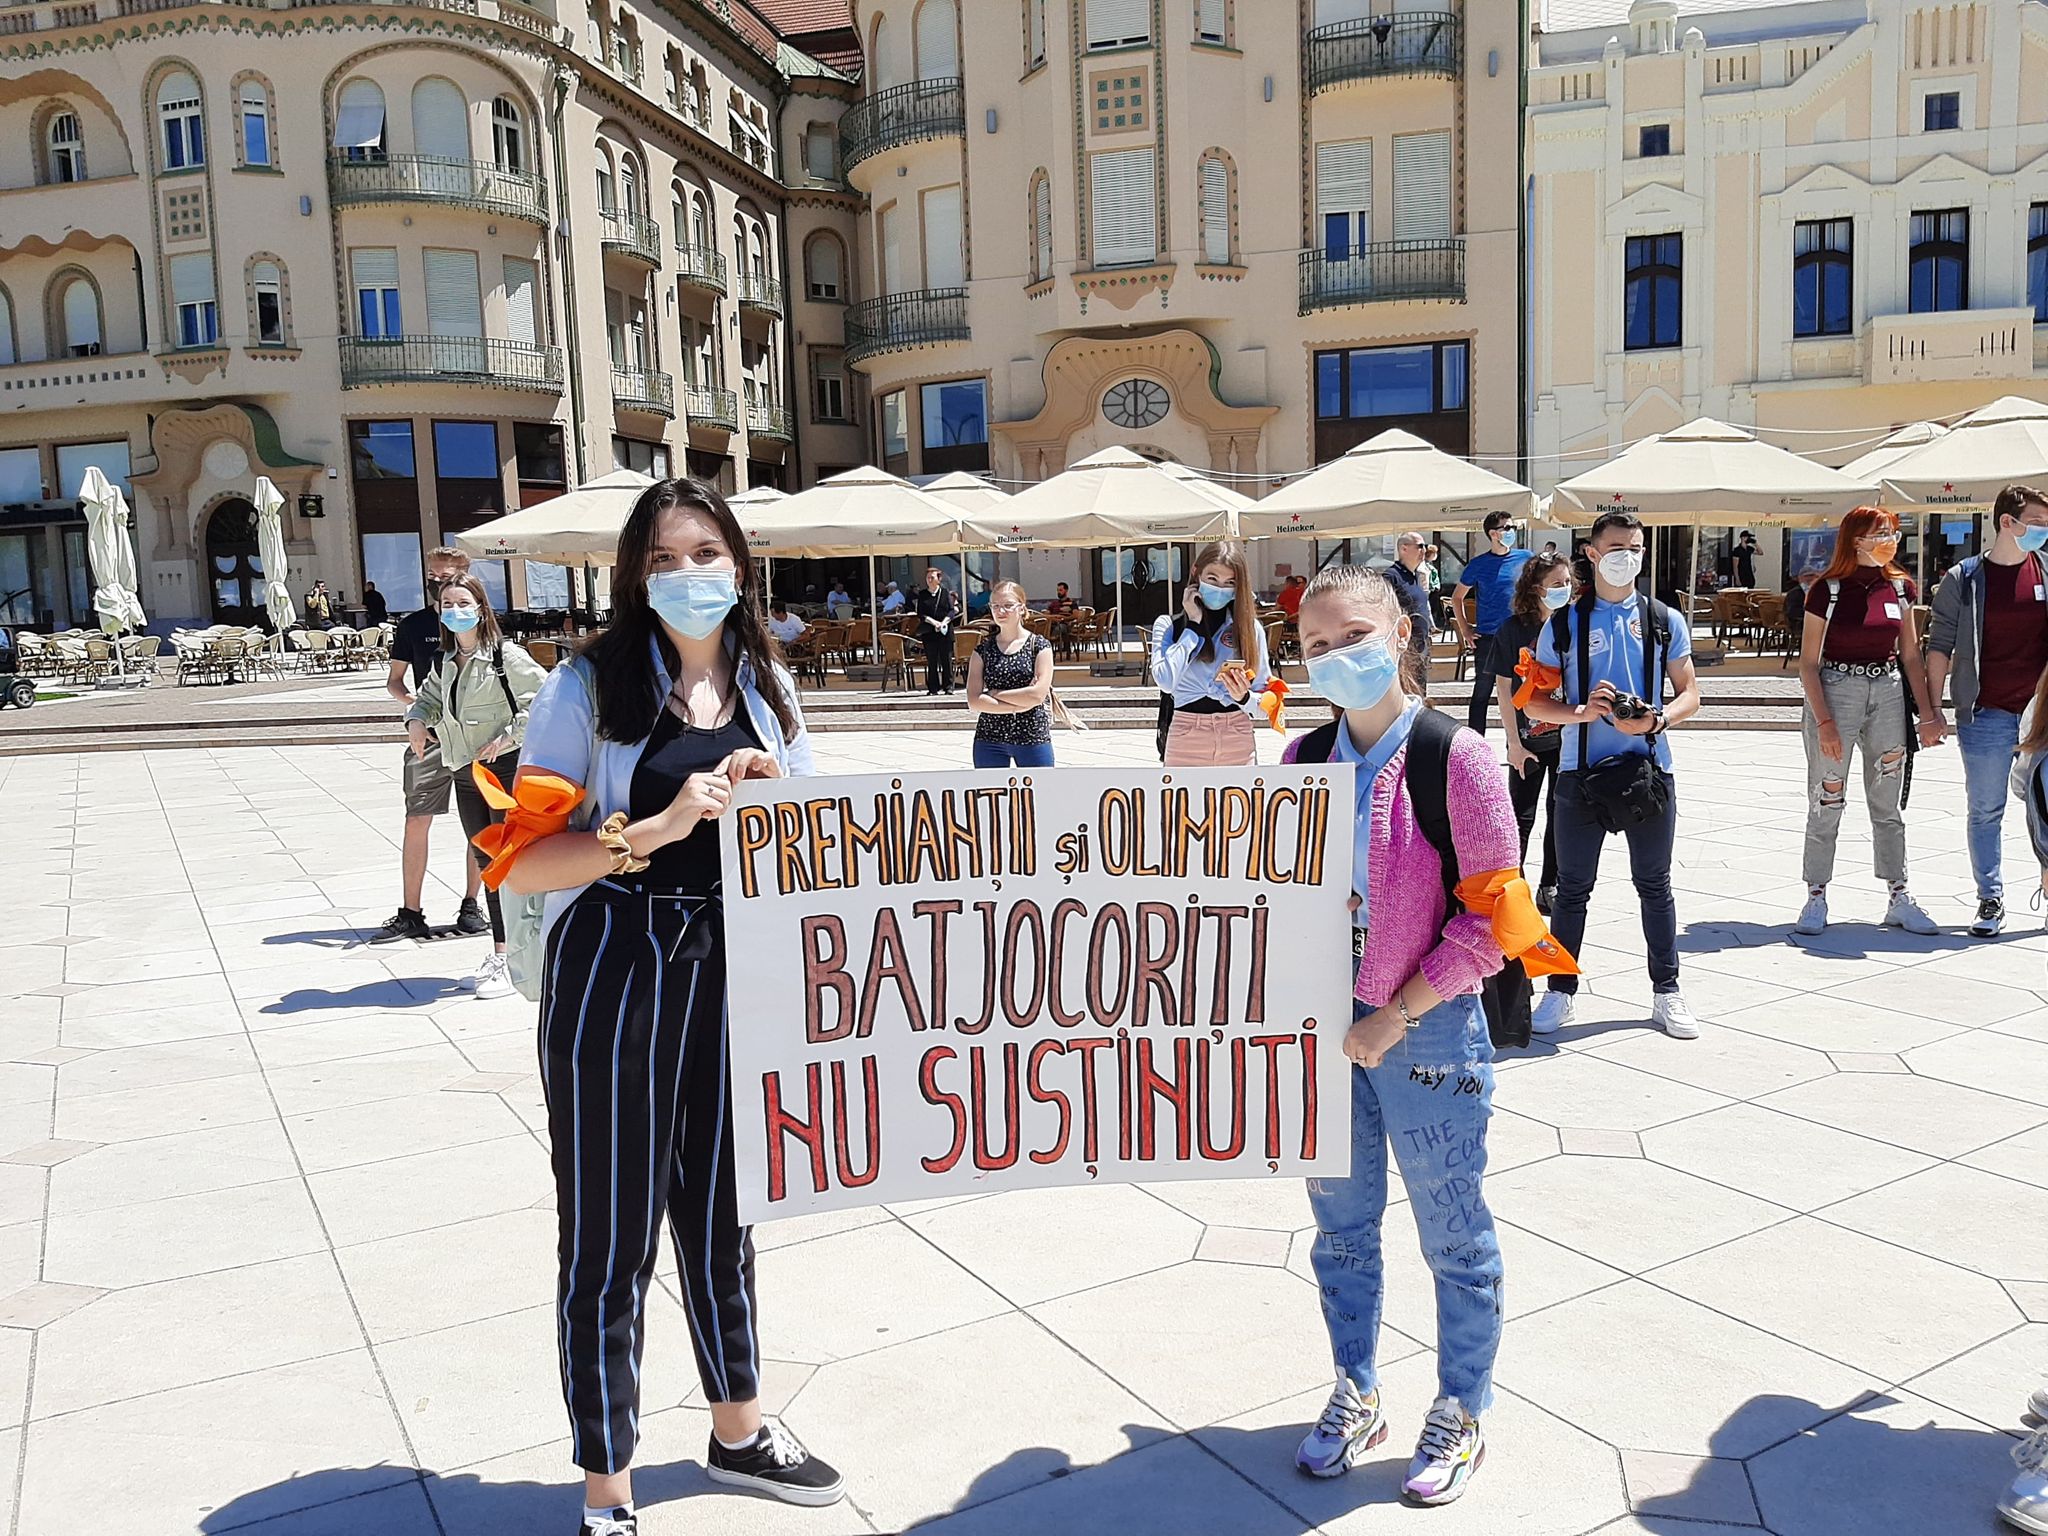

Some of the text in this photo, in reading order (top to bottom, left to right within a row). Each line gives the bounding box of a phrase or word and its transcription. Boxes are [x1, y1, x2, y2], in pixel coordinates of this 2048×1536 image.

[1926, 494, 1972, 503] Heineken
[1596, 504, 1639, 512] Heineken
[1276, 524, 1315, 532] Heineken
[997, 535, 1033, 543] Heineken
[1054, 823, 1089, 885] și
[1098, 774, 1330, 886] OLIMPICII
[1452, 1075, 1484, 1096] YOU
[761, 1017, 1318, 1203] NU SUSȚINUȚI
[1402, 1118, 1456, 1154] THE
